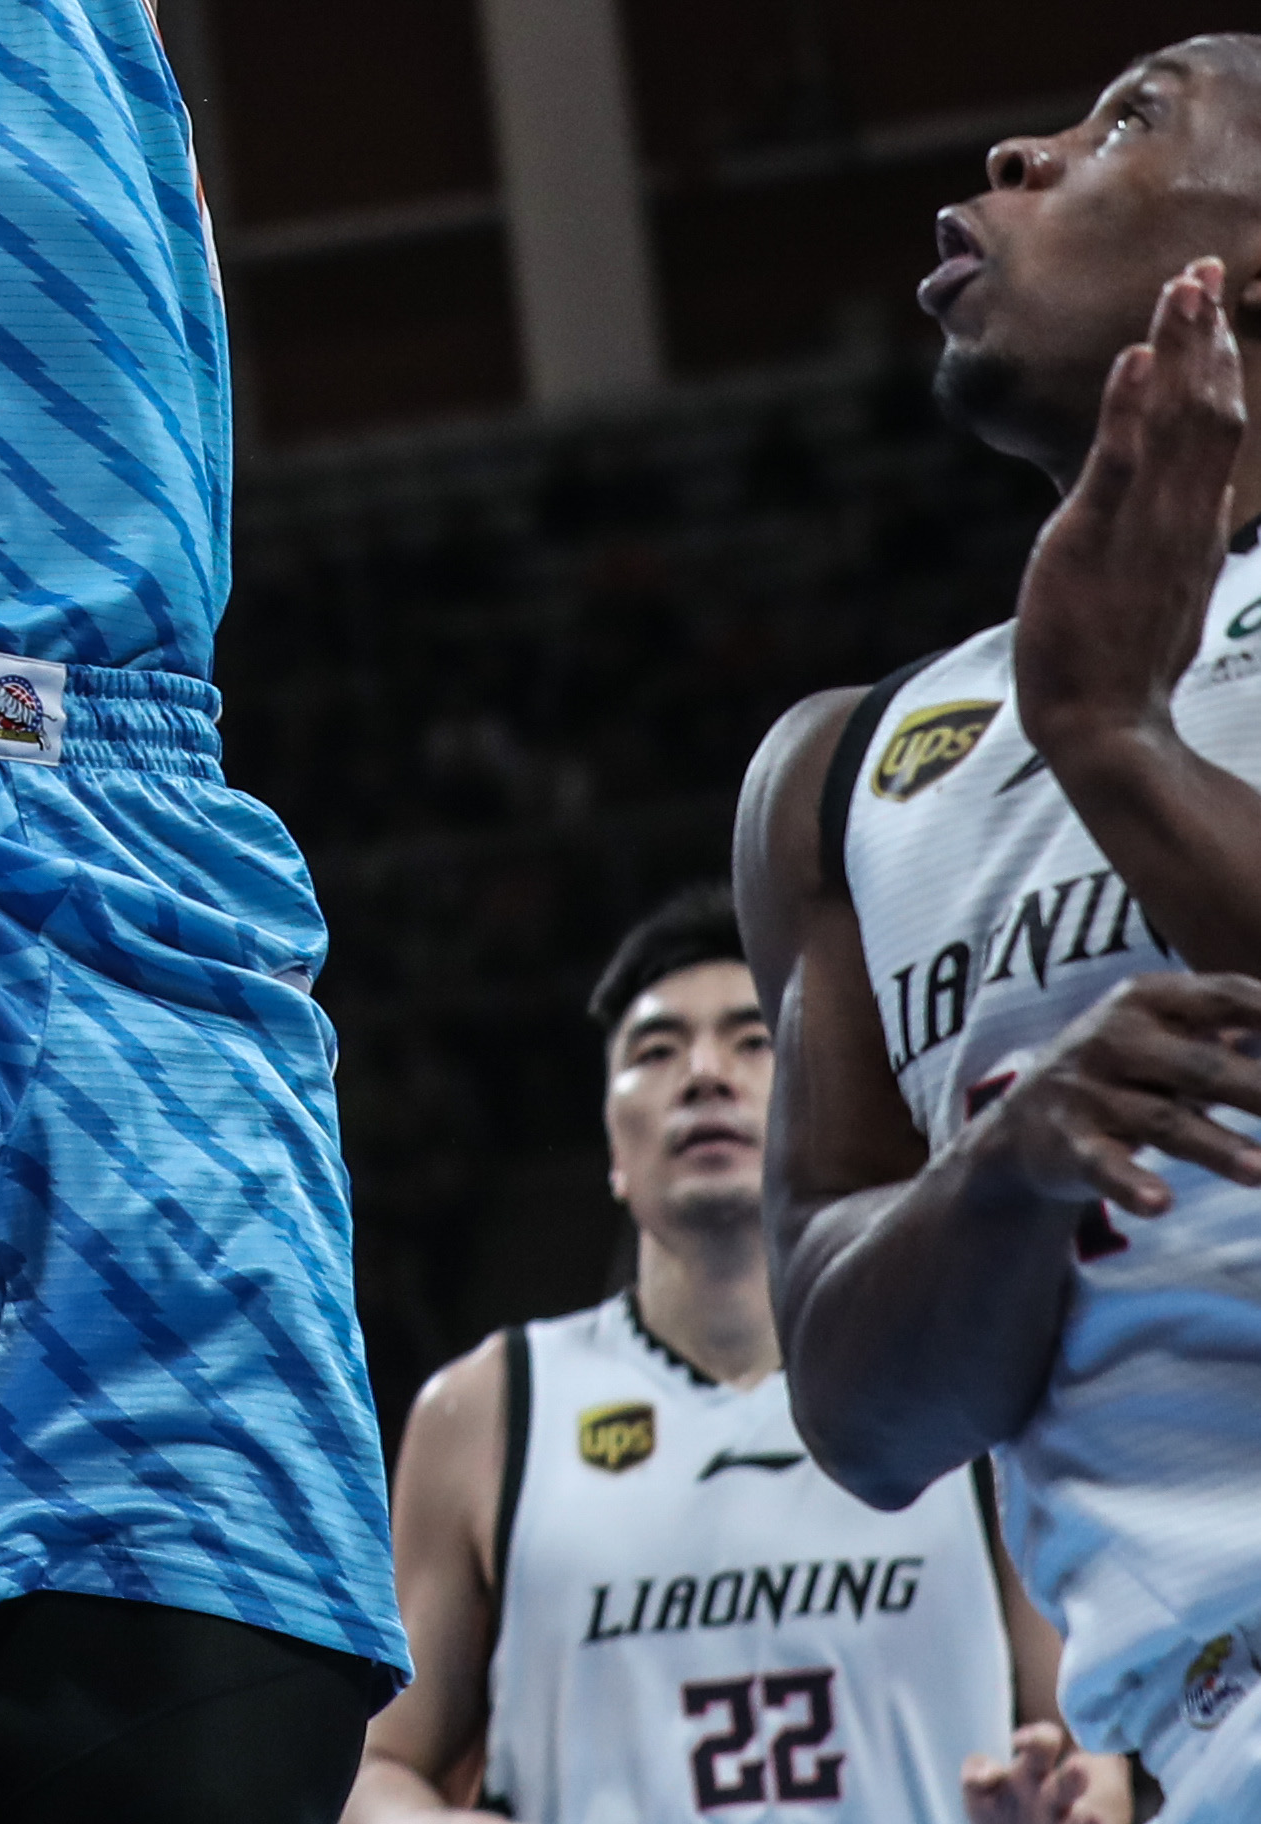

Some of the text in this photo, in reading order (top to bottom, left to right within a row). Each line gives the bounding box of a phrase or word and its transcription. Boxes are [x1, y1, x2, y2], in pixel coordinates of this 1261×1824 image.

[581, 1420, 653, 1465] ups
[582, 1557, 926, 1645] LIAONING
[681, 1667, 846, 1813] 22
